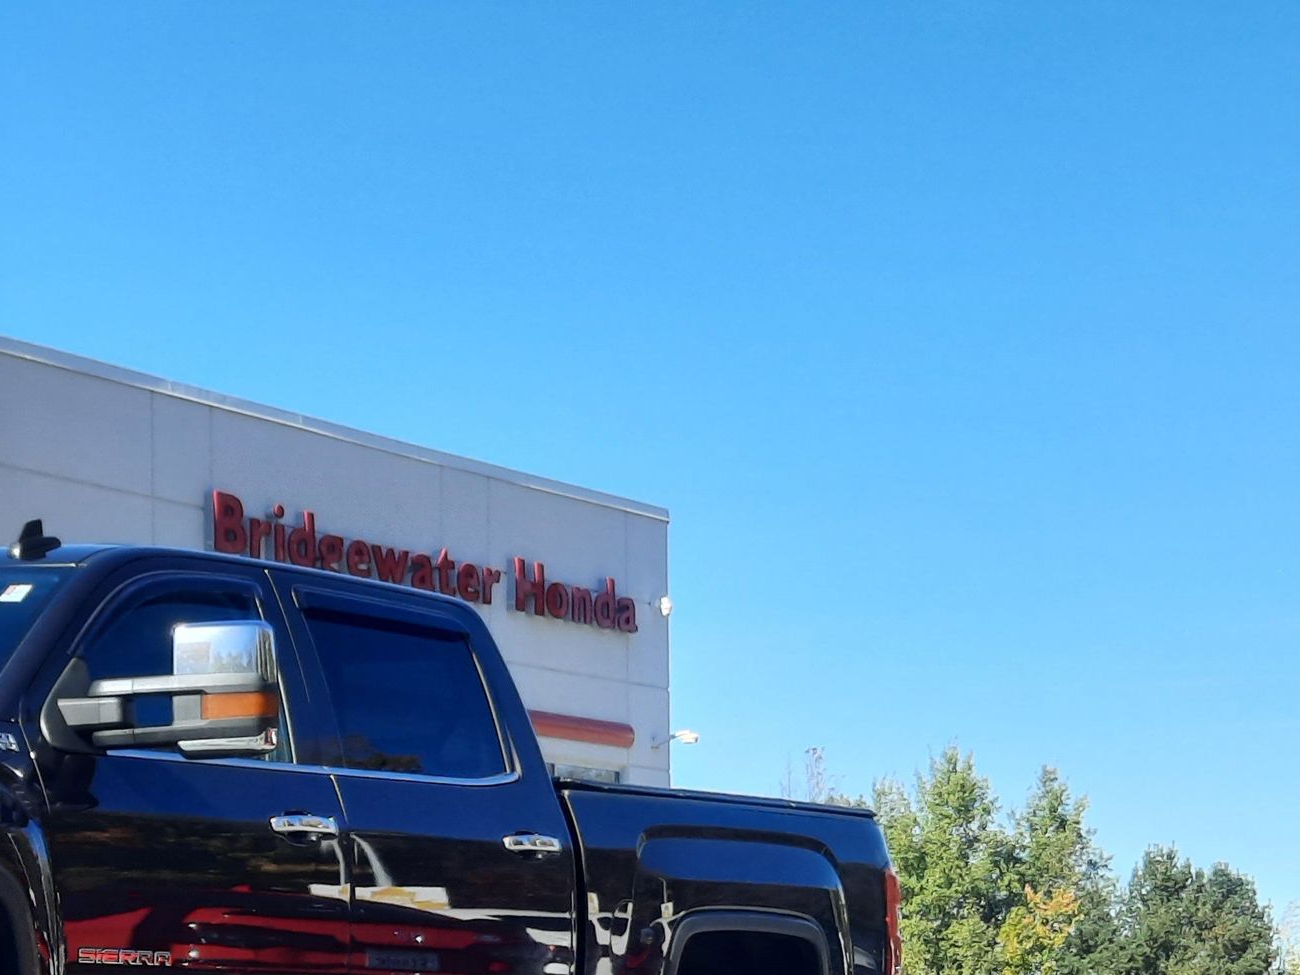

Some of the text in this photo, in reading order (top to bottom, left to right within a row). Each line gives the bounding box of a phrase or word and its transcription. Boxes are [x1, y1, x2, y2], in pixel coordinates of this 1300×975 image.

[212, 489, 638, 633] Bridgewater Honda
[78, 948, 172, 967] SIERRA
